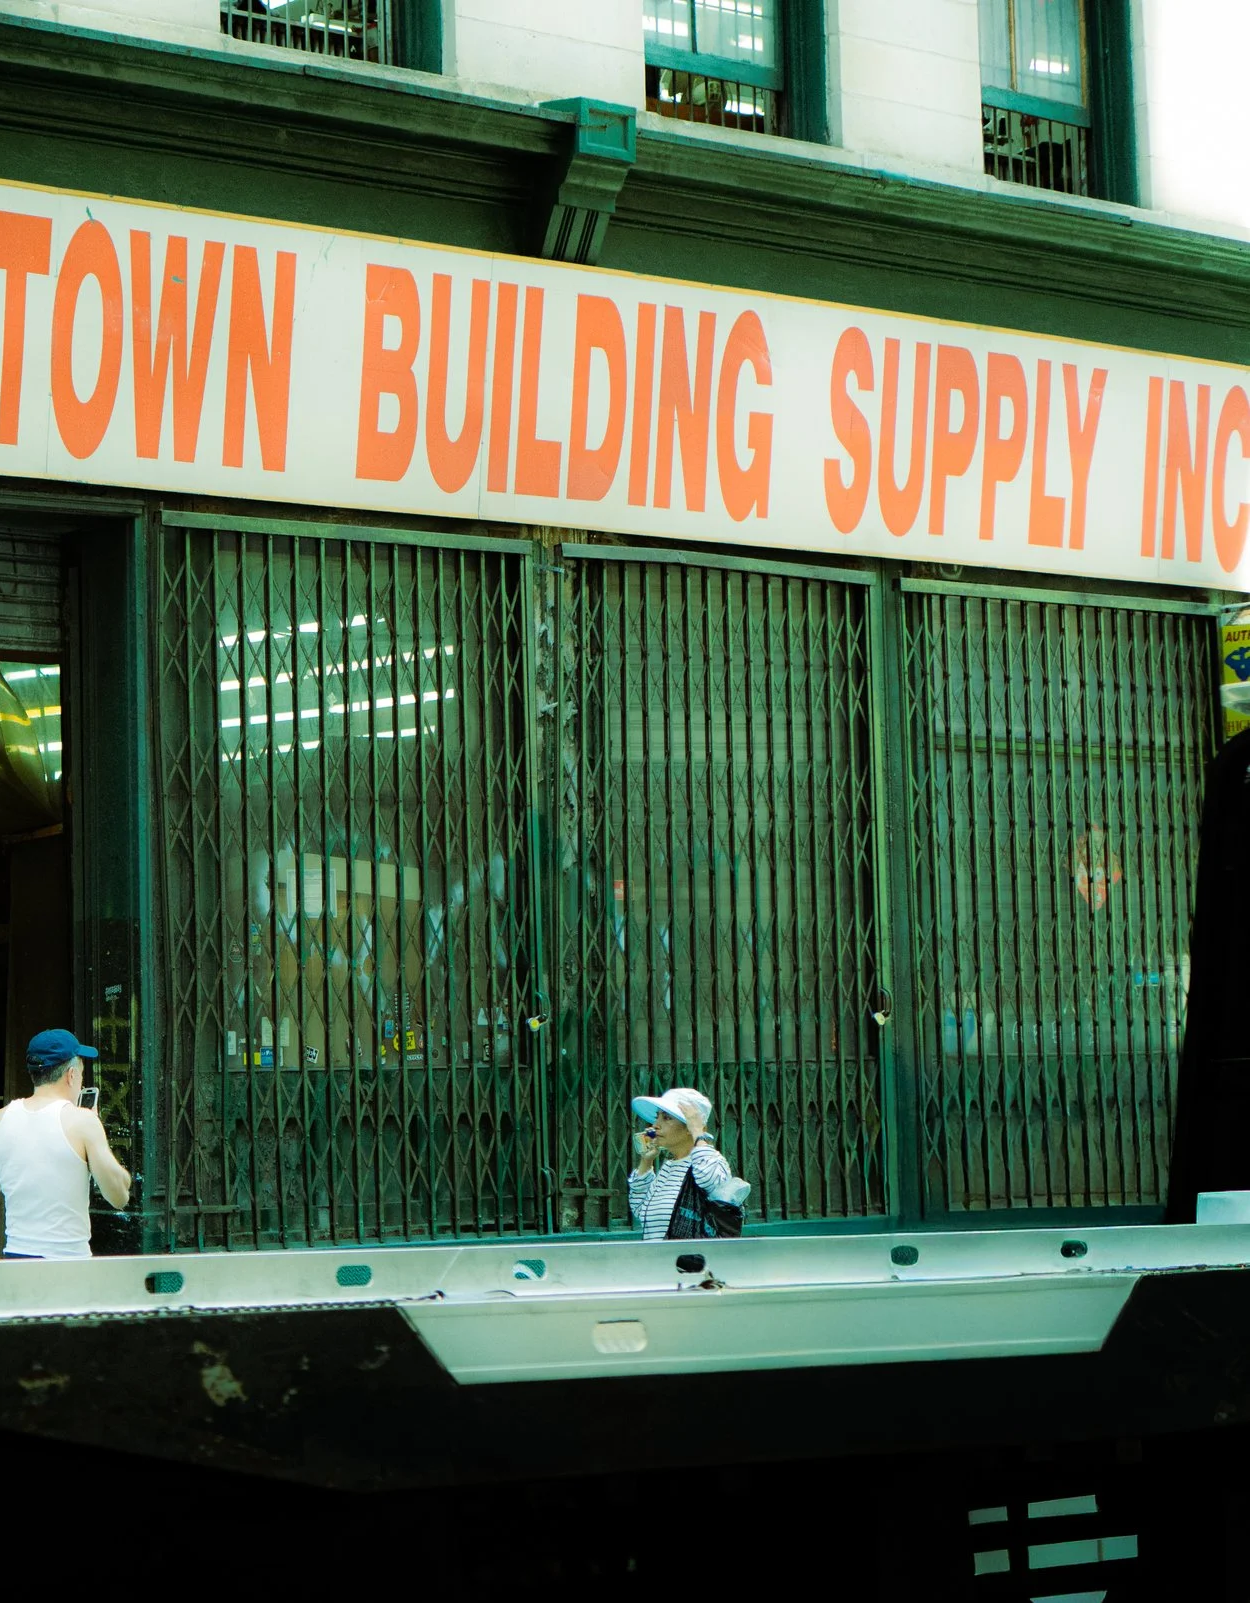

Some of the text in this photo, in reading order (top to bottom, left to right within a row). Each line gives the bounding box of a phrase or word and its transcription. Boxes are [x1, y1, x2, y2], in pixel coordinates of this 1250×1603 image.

[355, 263, 773, 522] BUILDING
[823, 327, 1107, 549] SUPPLY
[1141, 377, 1250, 572] INC
